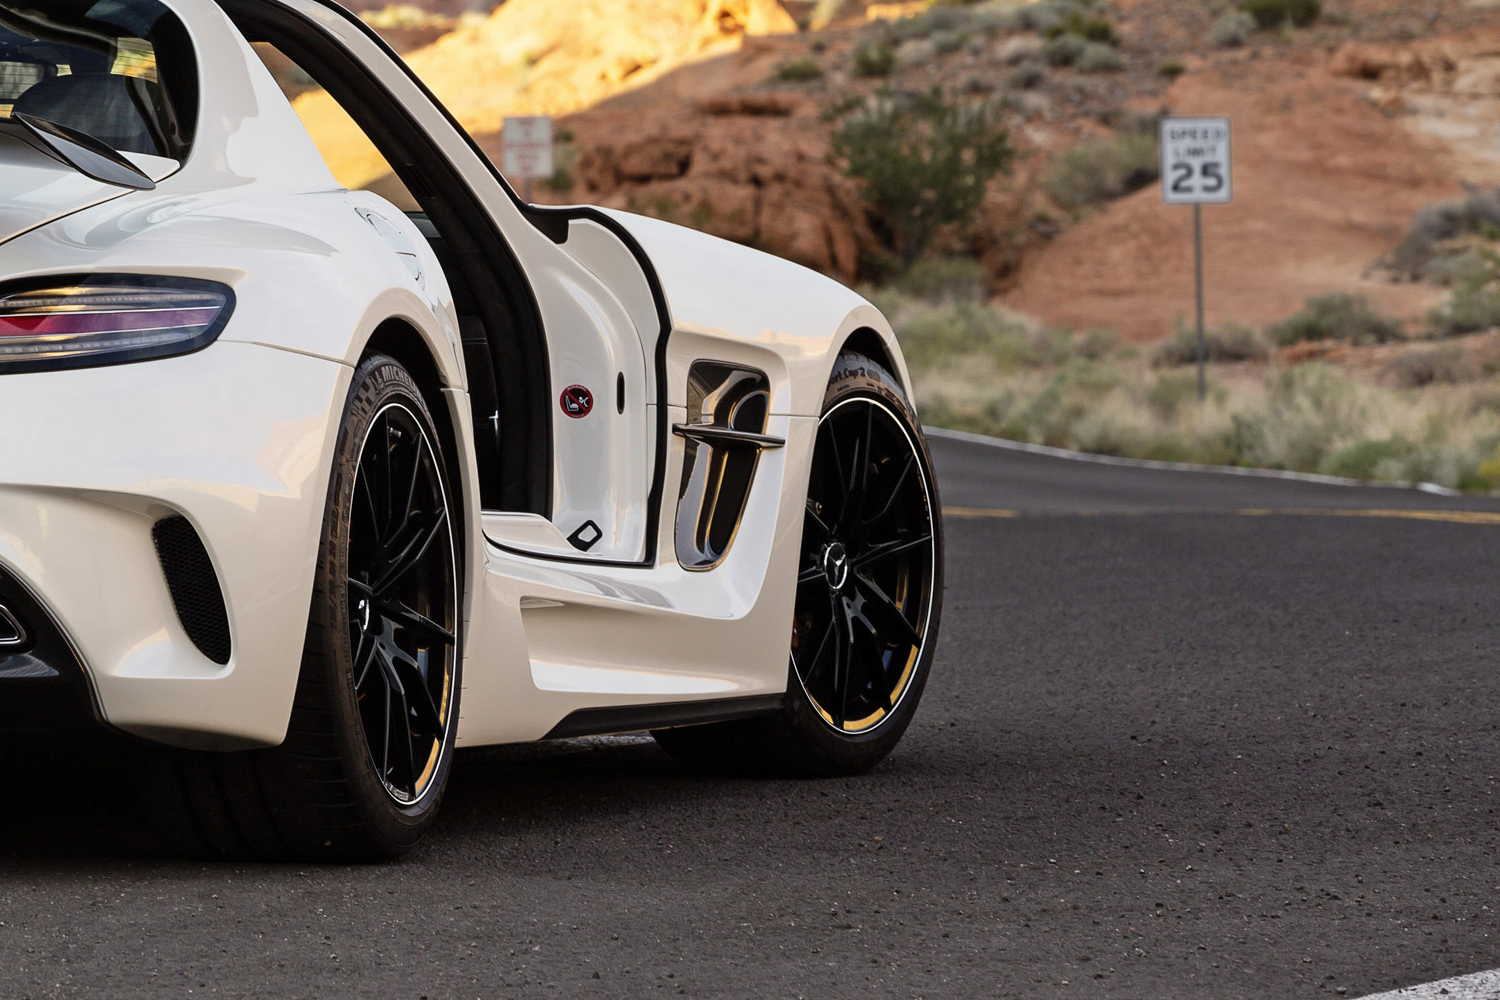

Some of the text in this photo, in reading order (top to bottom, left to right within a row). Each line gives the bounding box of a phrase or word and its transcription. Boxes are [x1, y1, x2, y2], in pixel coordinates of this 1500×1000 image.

[1171, 162, 1224, 193] 25
[843, 367, 858, 379] Cup
[859, 367, 866, 377] 2
